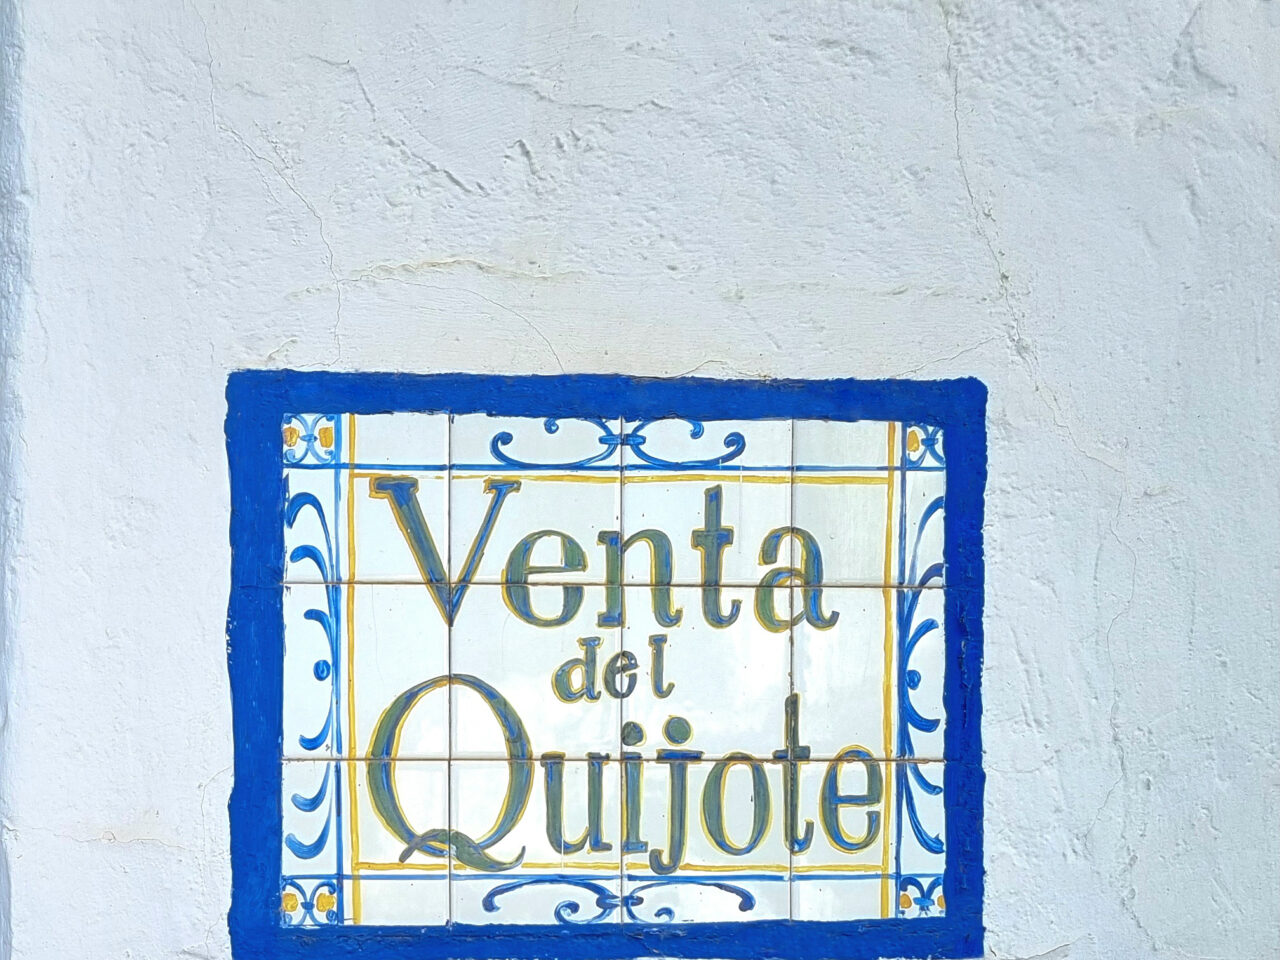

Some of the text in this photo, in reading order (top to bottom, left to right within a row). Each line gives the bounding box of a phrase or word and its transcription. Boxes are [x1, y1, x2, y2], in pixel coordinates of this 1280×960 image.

[369, 476, 840, 632] Venta
[553, 635, 674, 703] del
[366, 674, 885, 874] Quijote
